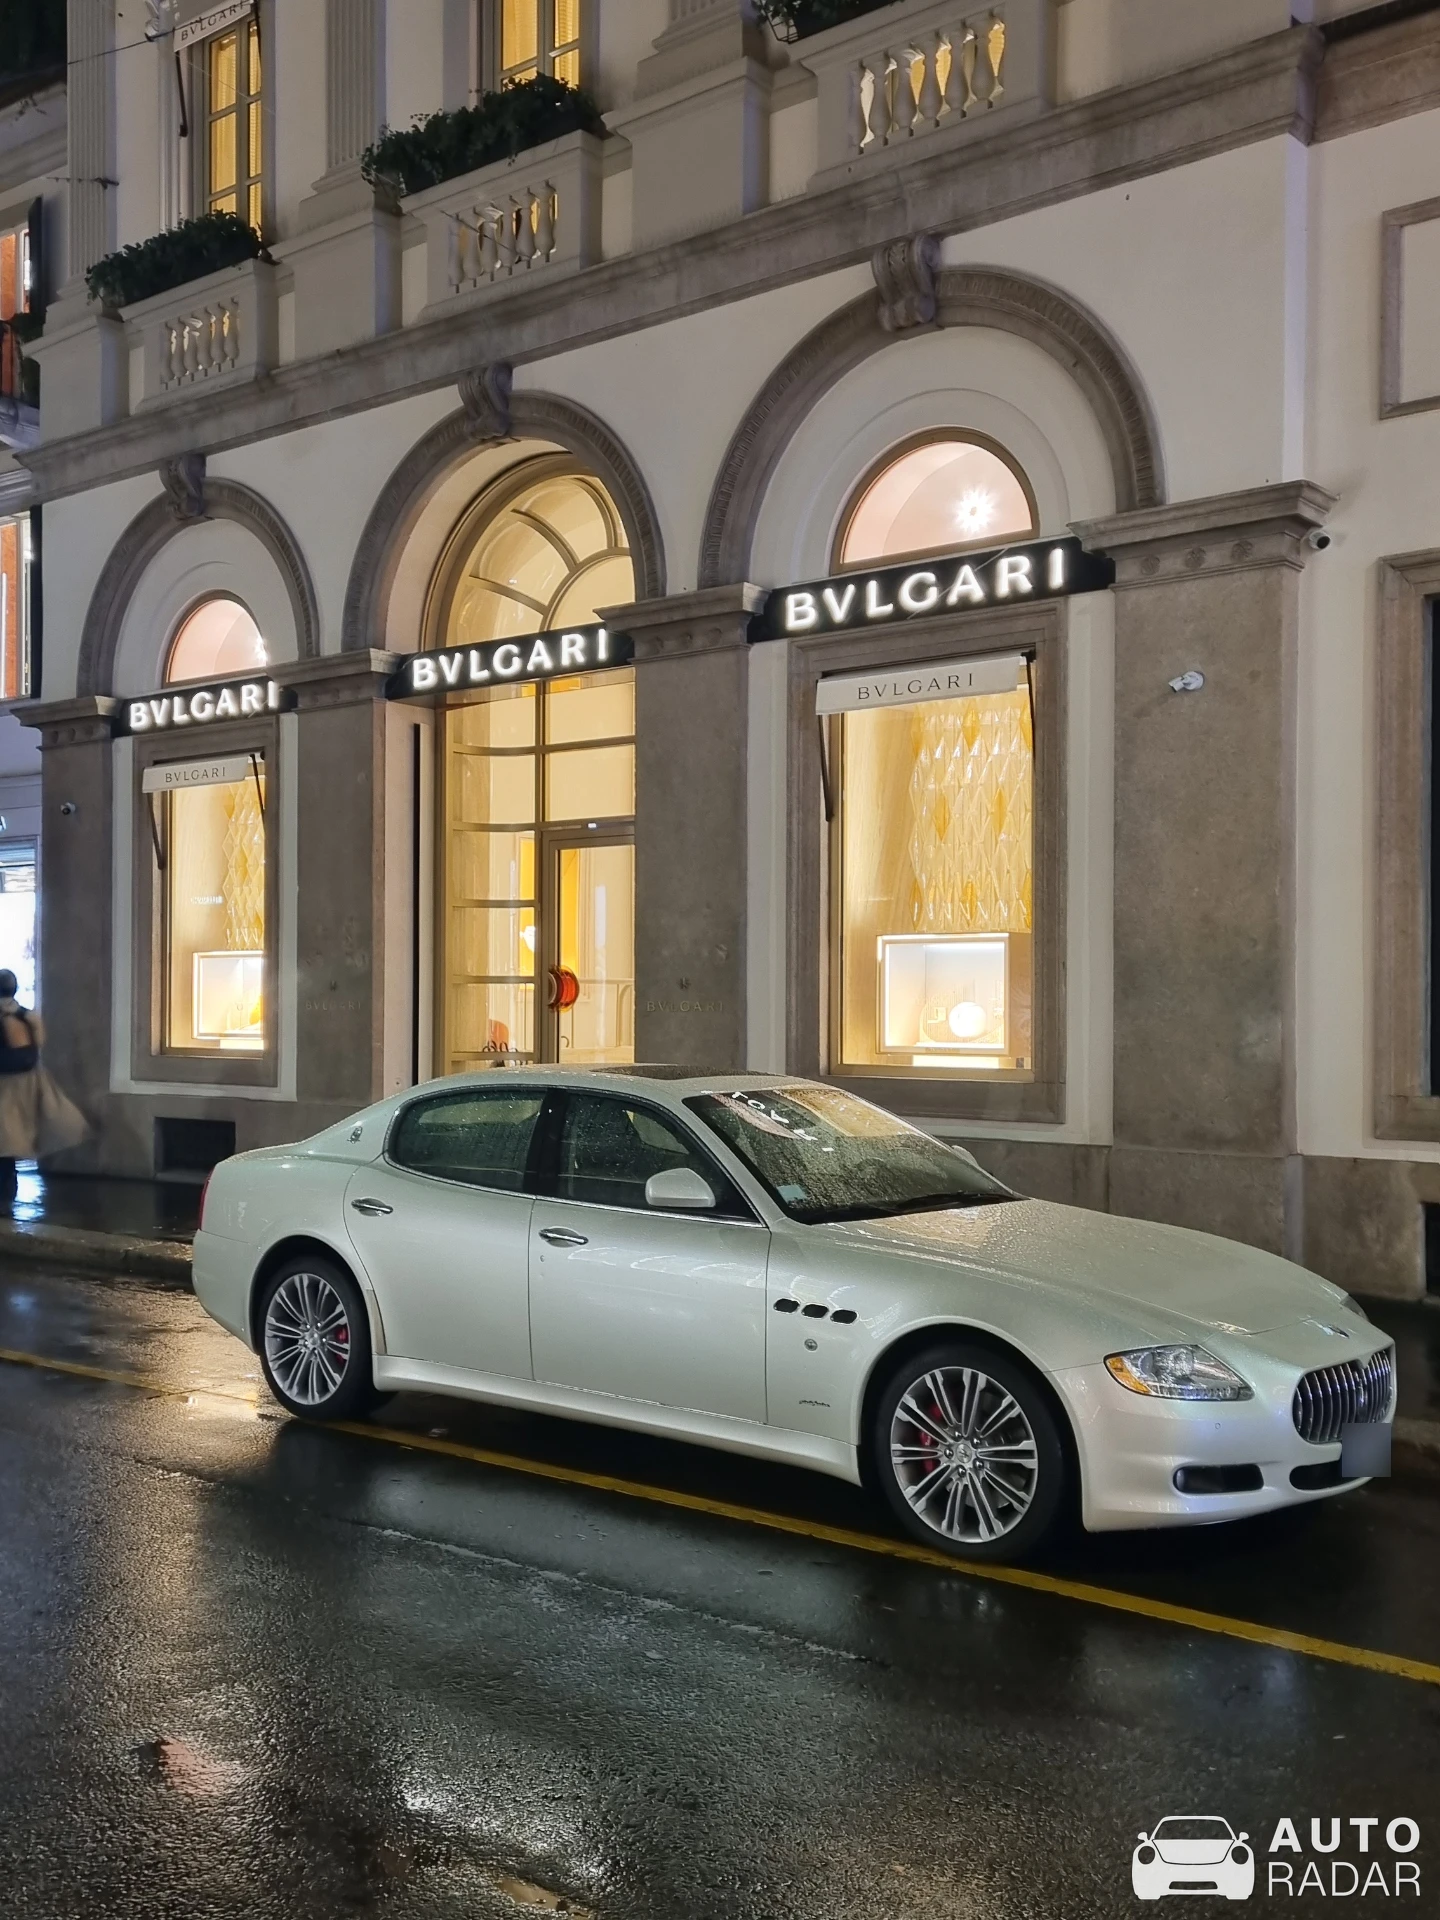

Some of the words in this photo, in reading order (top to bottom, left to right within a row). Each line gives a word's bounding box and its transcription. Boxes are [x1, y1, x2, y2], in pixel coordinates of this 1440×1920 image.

[784, 548, 1064, 632] BVLGARI
[412, 628, 607, 689] BVLGARI
[129, 680, 279, 731] BVLGARI
[858, 672, 974, 700] BVLGARI
[165, 766, 226, 783] BVLGARI
[646, 1000, 723, 1012] BVLGARI
